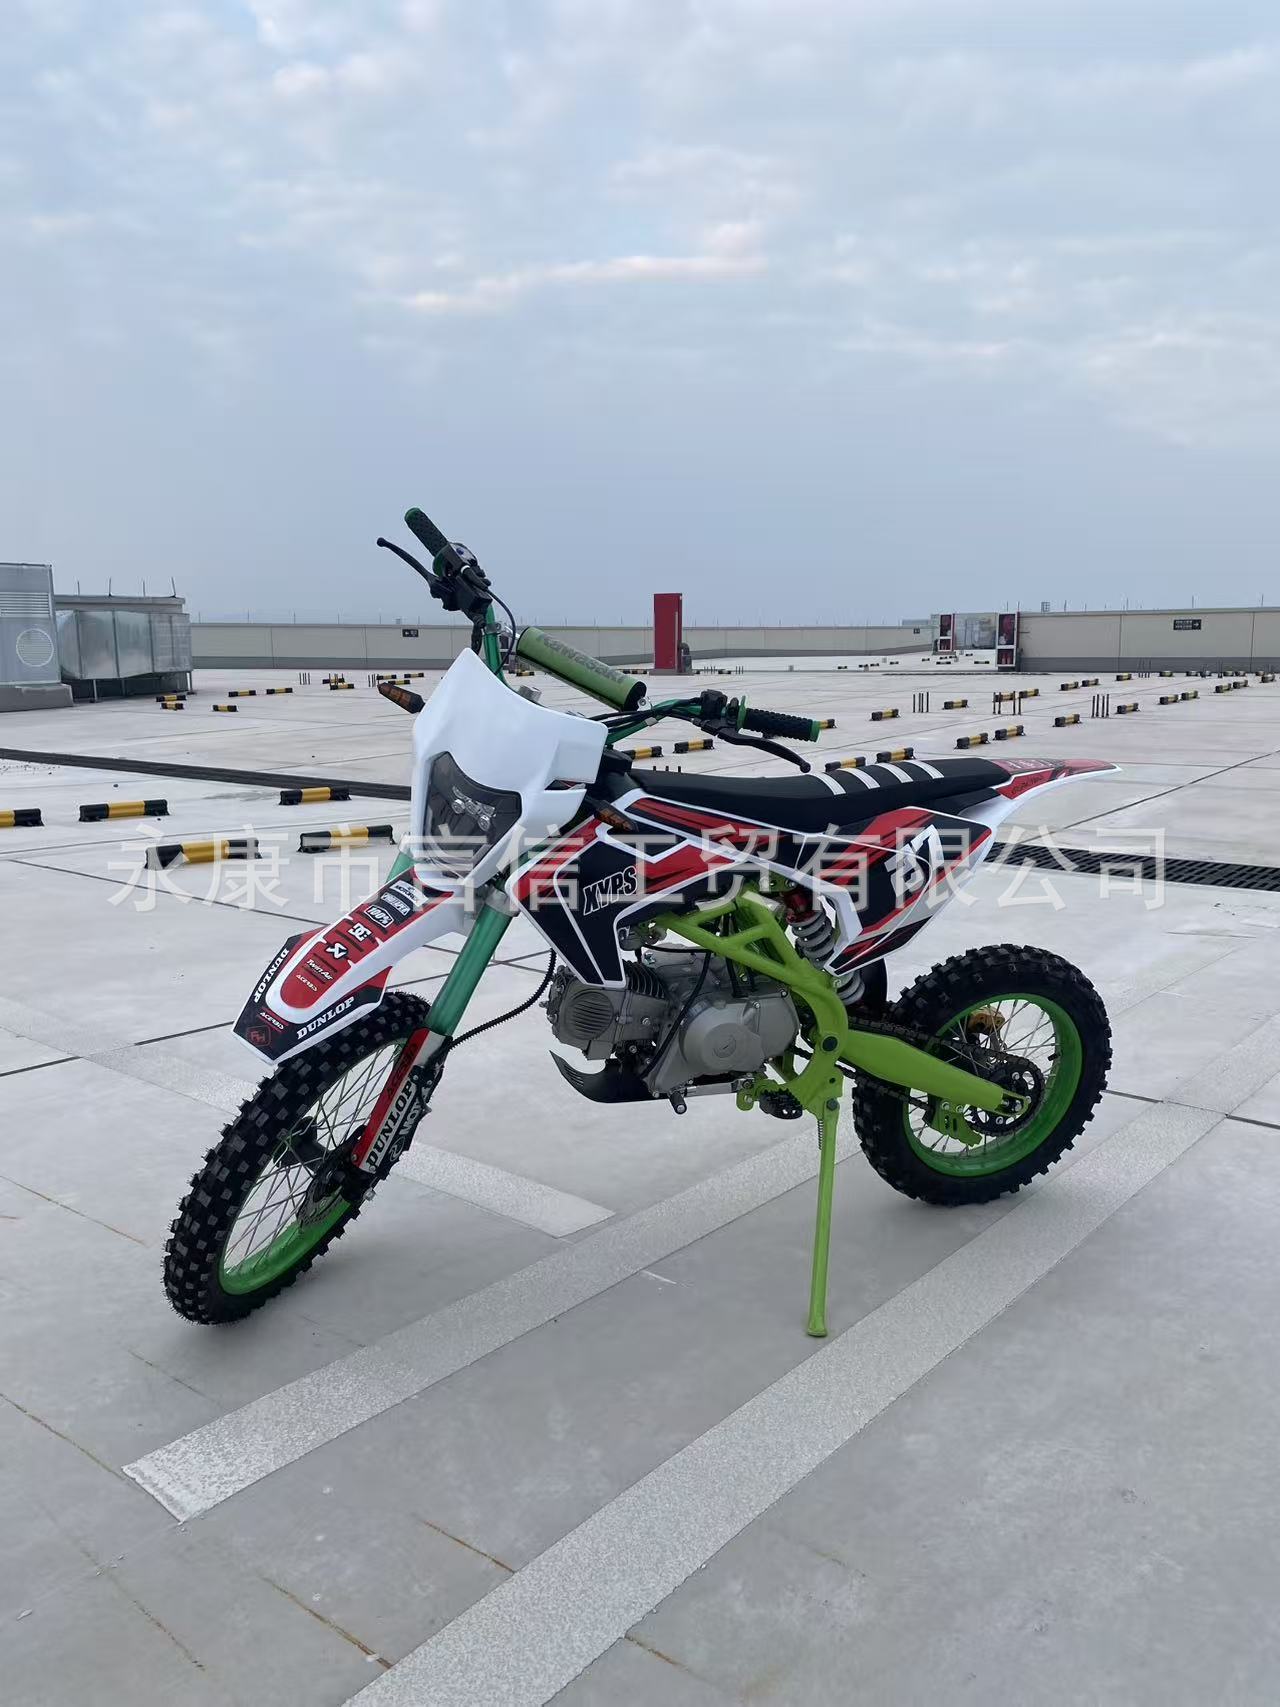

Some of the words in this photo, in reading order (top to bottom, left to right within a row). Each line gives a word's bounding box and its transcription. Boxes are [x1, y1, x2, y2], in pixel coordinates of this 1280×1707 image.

[368, 905, 391, 925] 100%
[254, 948, 290, 1003] DUNLOP
[297, 996, 354, 1040] DUNLOP
[365, 1080, 417, 1169] DUNLOP
